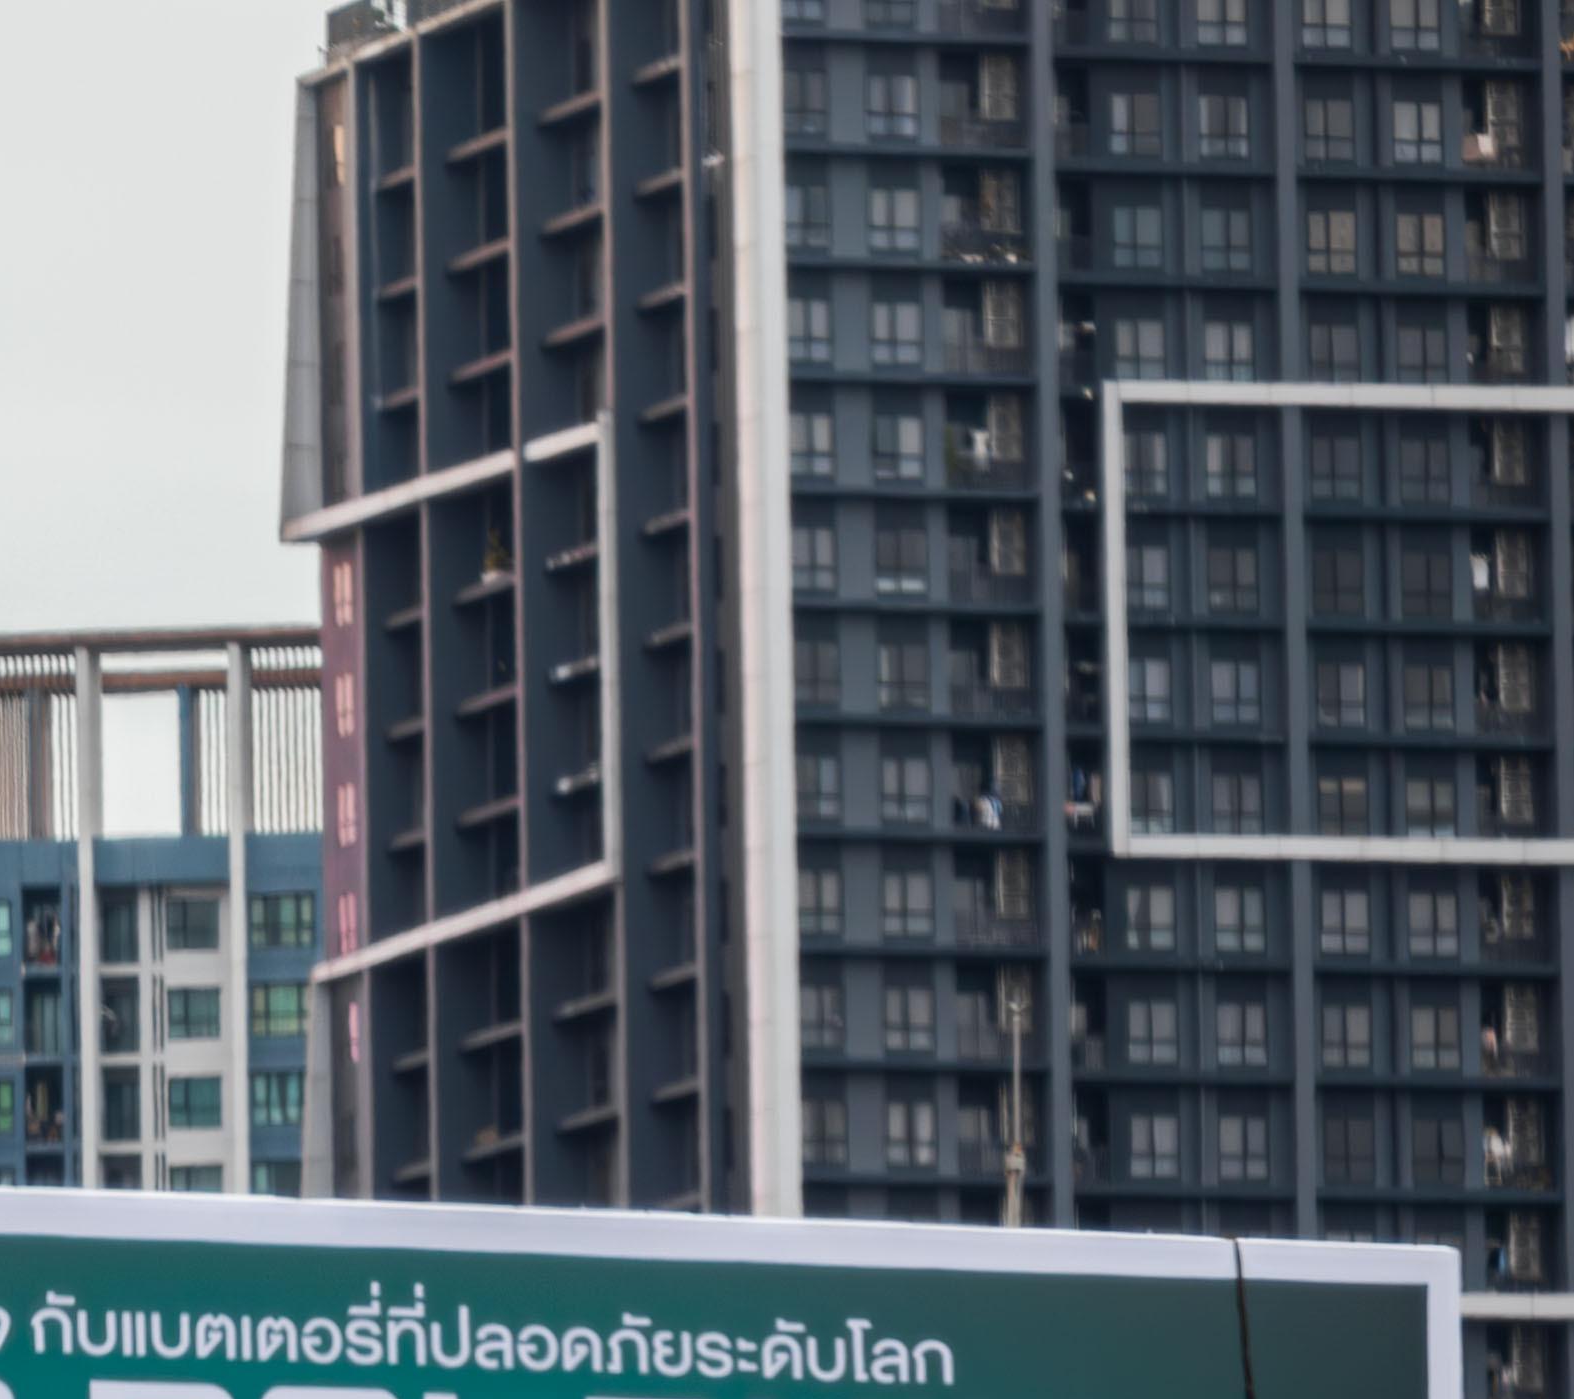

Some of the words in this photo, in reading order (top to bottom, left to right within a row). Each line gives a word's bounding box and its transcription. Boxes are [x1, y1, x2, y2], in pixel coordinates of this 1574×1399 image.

[30, 1282, 955, 1386] กับแบตเตอรี่ที่ปลอดภัยระดับโลก
